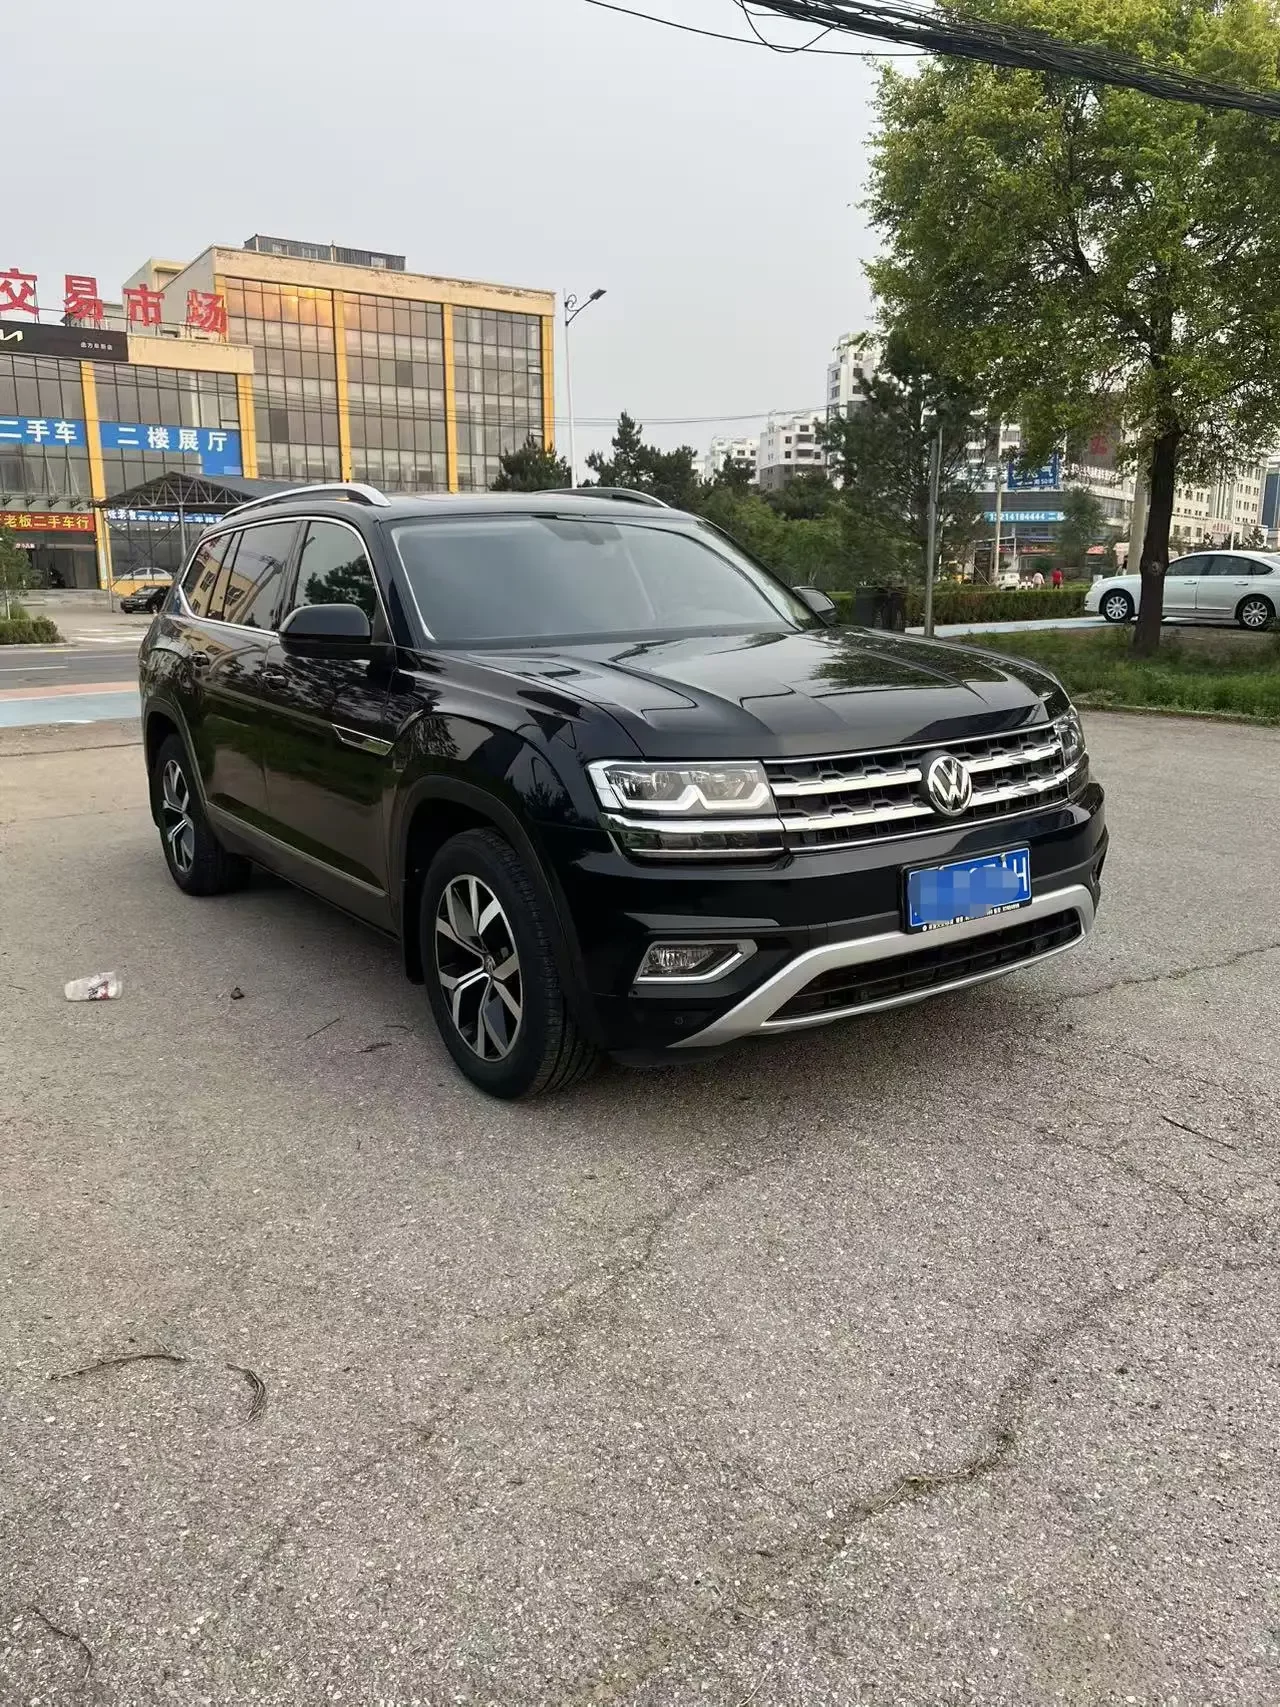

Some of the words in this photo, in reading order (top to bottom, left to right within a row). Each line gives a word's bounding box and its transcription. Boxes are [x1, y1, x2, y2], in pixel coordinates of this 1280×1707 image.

[0, 420, 77, 444] 二手车
[117, 426, 228, 453] 二楼展厅
[0, 513, 90, 529] 老板二手车行
